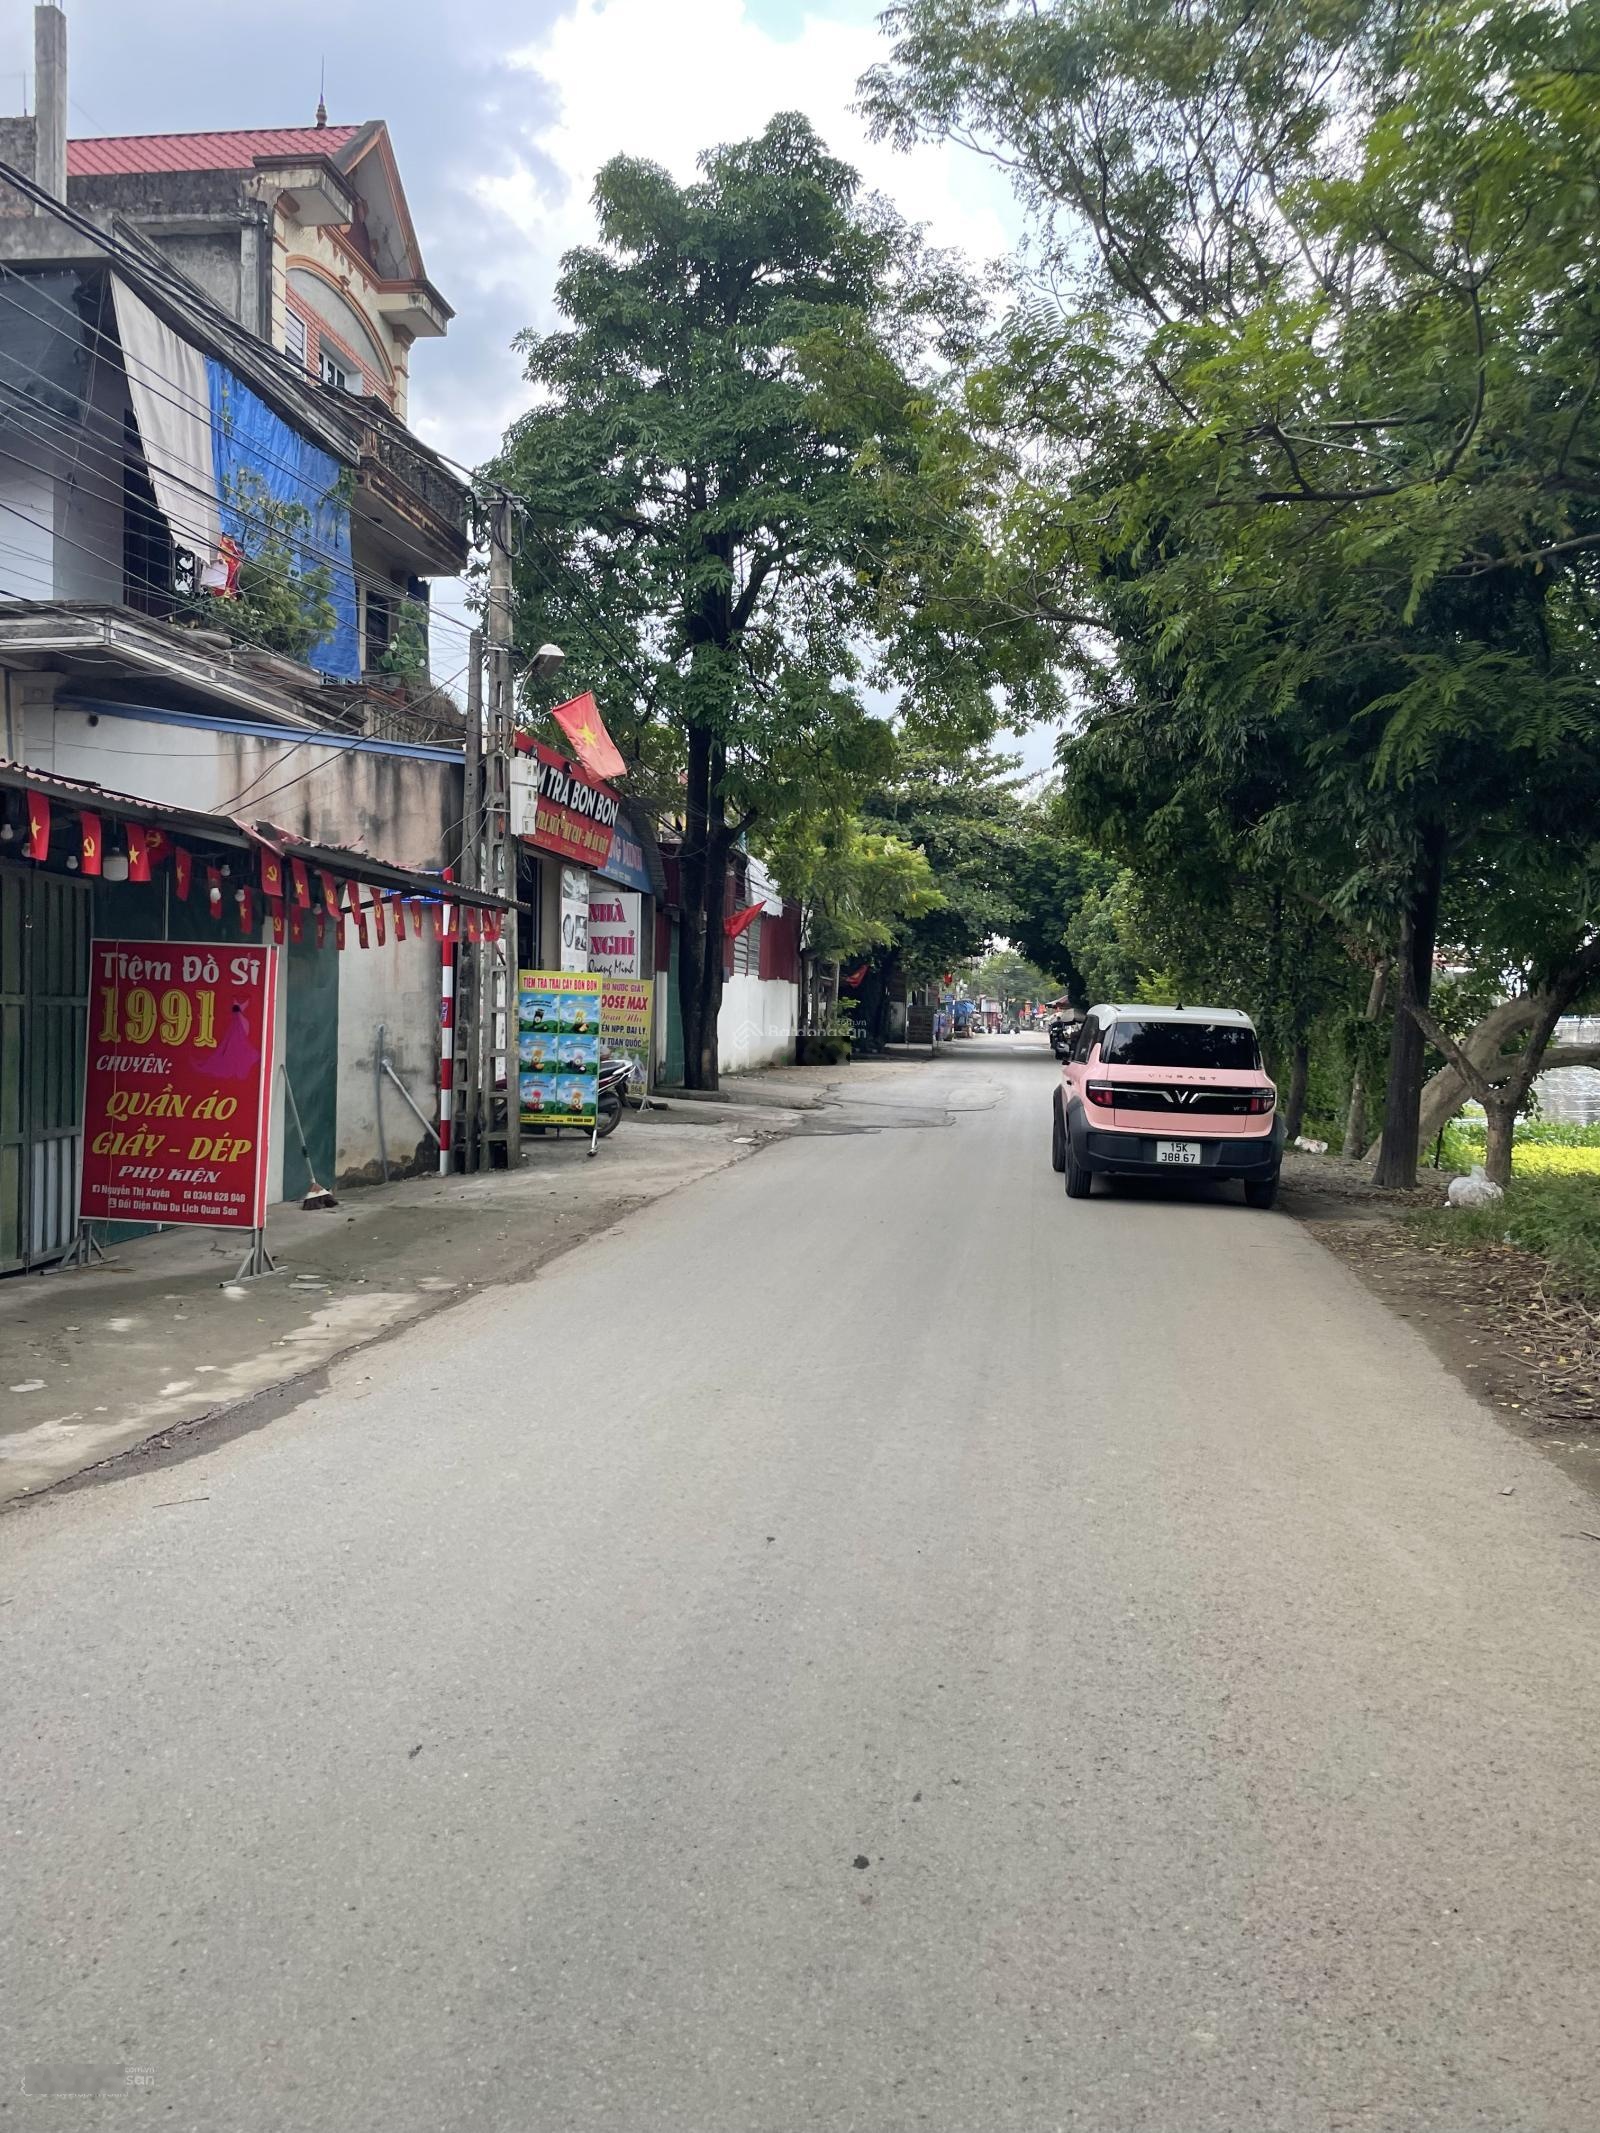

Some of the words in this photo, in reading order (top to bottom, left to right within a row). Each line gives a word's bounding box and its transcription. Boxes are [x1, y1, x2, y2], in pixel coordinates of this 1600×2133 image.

[570, 781, 598, 817] BON
[595, 795, 619, 827] BON
[588, 897, 626, 923] NHÀ
[590, 929, 635, 956] NGHỈ
[101, 952, 172, 986] Tiệm
[182, 953, 220, 984] Đồ
[588, 959, 613, 979] Quang
[614, 959, 634, 974] Minh
[626, 995, 649, 1011] MAX
[98, 986, 218, 1048] 1991
[96, 1053, 173, 1075] CHUYÊN:
[192, 1089, 238, 1121] ÁO
[187, 1132, 253, 1163] DÉP
[1170, 1143, 1188, 1153] 15K
[118, 1165, 165, 1183] PHỤ
[167, 1167, 222, 1185] KIỆN
[132, 1186, 144, 1198] Thị
[152, 1201, 168, 1211] Khu
[170, 1203, 180, 1212] Du
